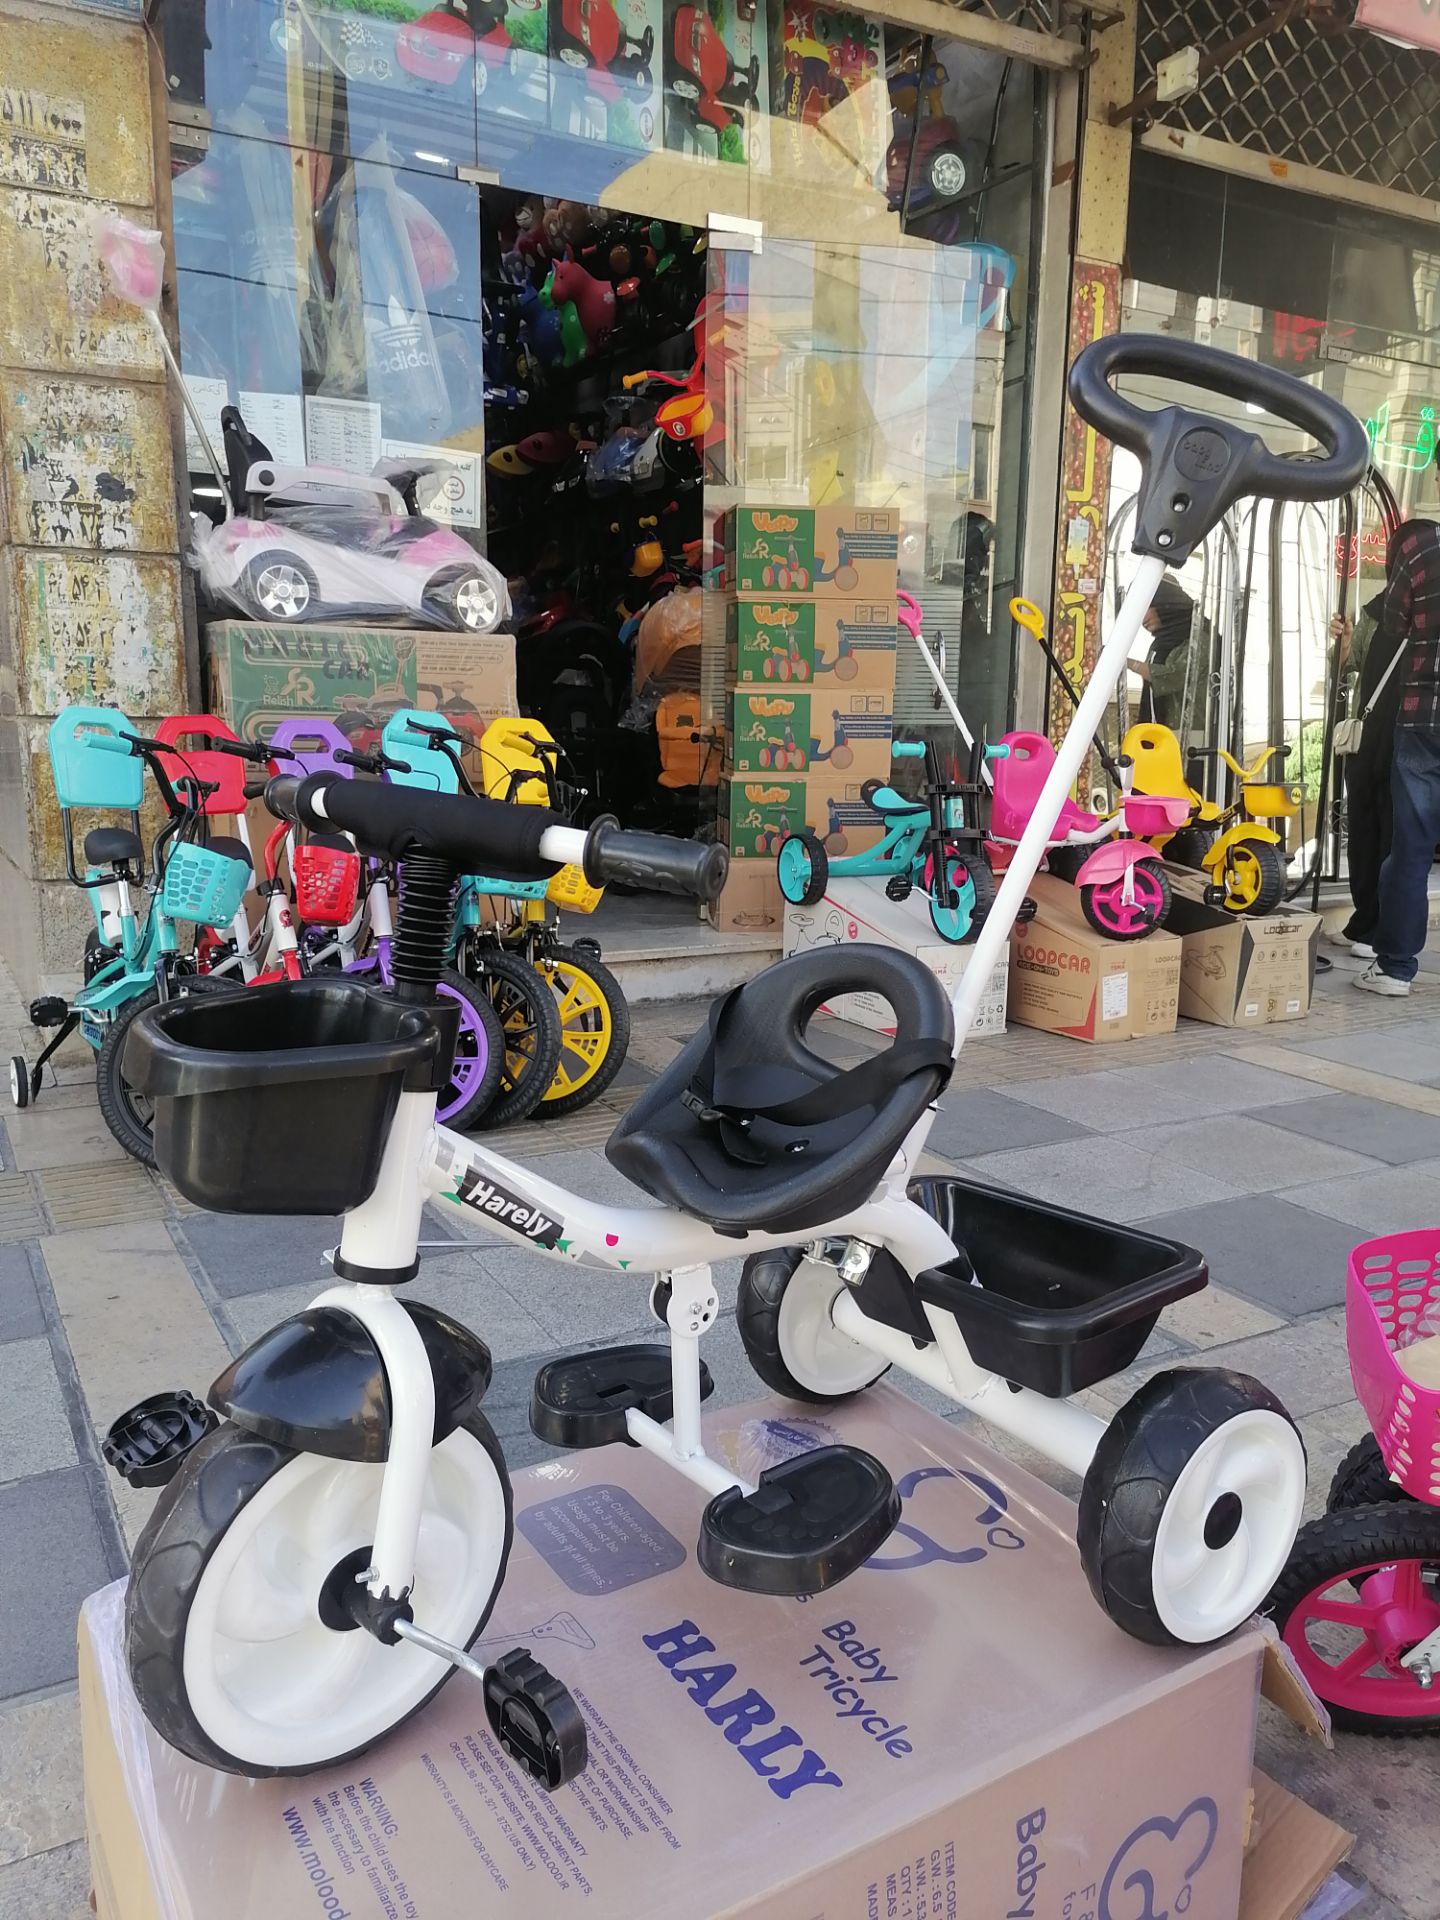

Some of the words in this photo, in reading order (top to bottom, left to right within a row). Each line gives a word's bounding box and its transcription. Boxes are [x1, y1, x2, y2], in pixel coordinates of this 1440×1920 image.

[262, 693, 296, 707] Relish
[322, 660, 371, 682] CAR
[1016, 943, 1091, 975] LOOPCAR
[466, 1180, 553, 1237] Harely
[550, 1503, 600, 1555] accompanied
[610, 1500, 643, 1533] Children
[821, 1619, 899, 1683] Baby
[641, 1618, 844, 1801] HARLY
[798, 1643, 914, 1760] Tricycle
[580, 1698, 609, 1731] WARRANT
[604, 1729, 619, 1744] THE
[638, 1773, 674, 1815] CONSUMER
[588, 1731, 605, 1749] THAT
[601, 1748, 618, 1766] THIS
[613, 1764, 643, 1800] PRODUCT
[638, 1797, 649, 1807] IS
[644, 1806, 664, 1827] FREE
[659, 1826, 681, 1850] FROM
[591, 1786, 603, 1798] OF
[312, 1796, 330, 1818] with
[322, 1816, 335, 1834] the
[329, 1832, 356, 1875] function
[359, 1777, 401, 1840] WARNING:
[420, 1753, 449, 1792] WARRANTY
[443, 1790, 453, 1800] IS
[471, 1836, 486, 1853] FOR
[480, 1852, 509, 1892] DAYCARE
[449, 1741, 461, 1754] OR
[456, 1751, 472, 1771] CALL
[515, 1846, 536, 1872] ONLY)
[464, 1735, 486, 1762] PLEASE
[480, 1760, 495, 1776] SEE
[489, 1774, 505, 1791] OUR
[522, 1823, 570, 1890] WWW.MOLOOD.IR
[495, 1754, 510, 1771] AND
[505, 1770, 530, 1801] SERVICE
[525, 1799, 538, 1813] OR
[533, 1811, 575, 1868] REPLACEMENT
[534, 1787, 558, 1816] LIMITED
[553, 1815, 587, 1859] WARRANTY
[597, 1767, 610, 1780] OR
[605, 1778, 650, 1834] WORKMANSHIP
[327, 1790, 343, 1811] the
[335, 1807, 365, 1857] necessary
[360, 1855, 370, 1868] to
[366, 1865, 398, 1920] familiarize
[343, 1784, 365, 1816] Before
[359, 1815, 373, 1833] the
[368, 1832, 389, 1857] child
[381, 1857, 399, 1883] uses
[393, 1881, 409, 1901] the
[944, 1840, 956, 1878] ITEM
[1006, 1806, 1047, 1920] Baby
